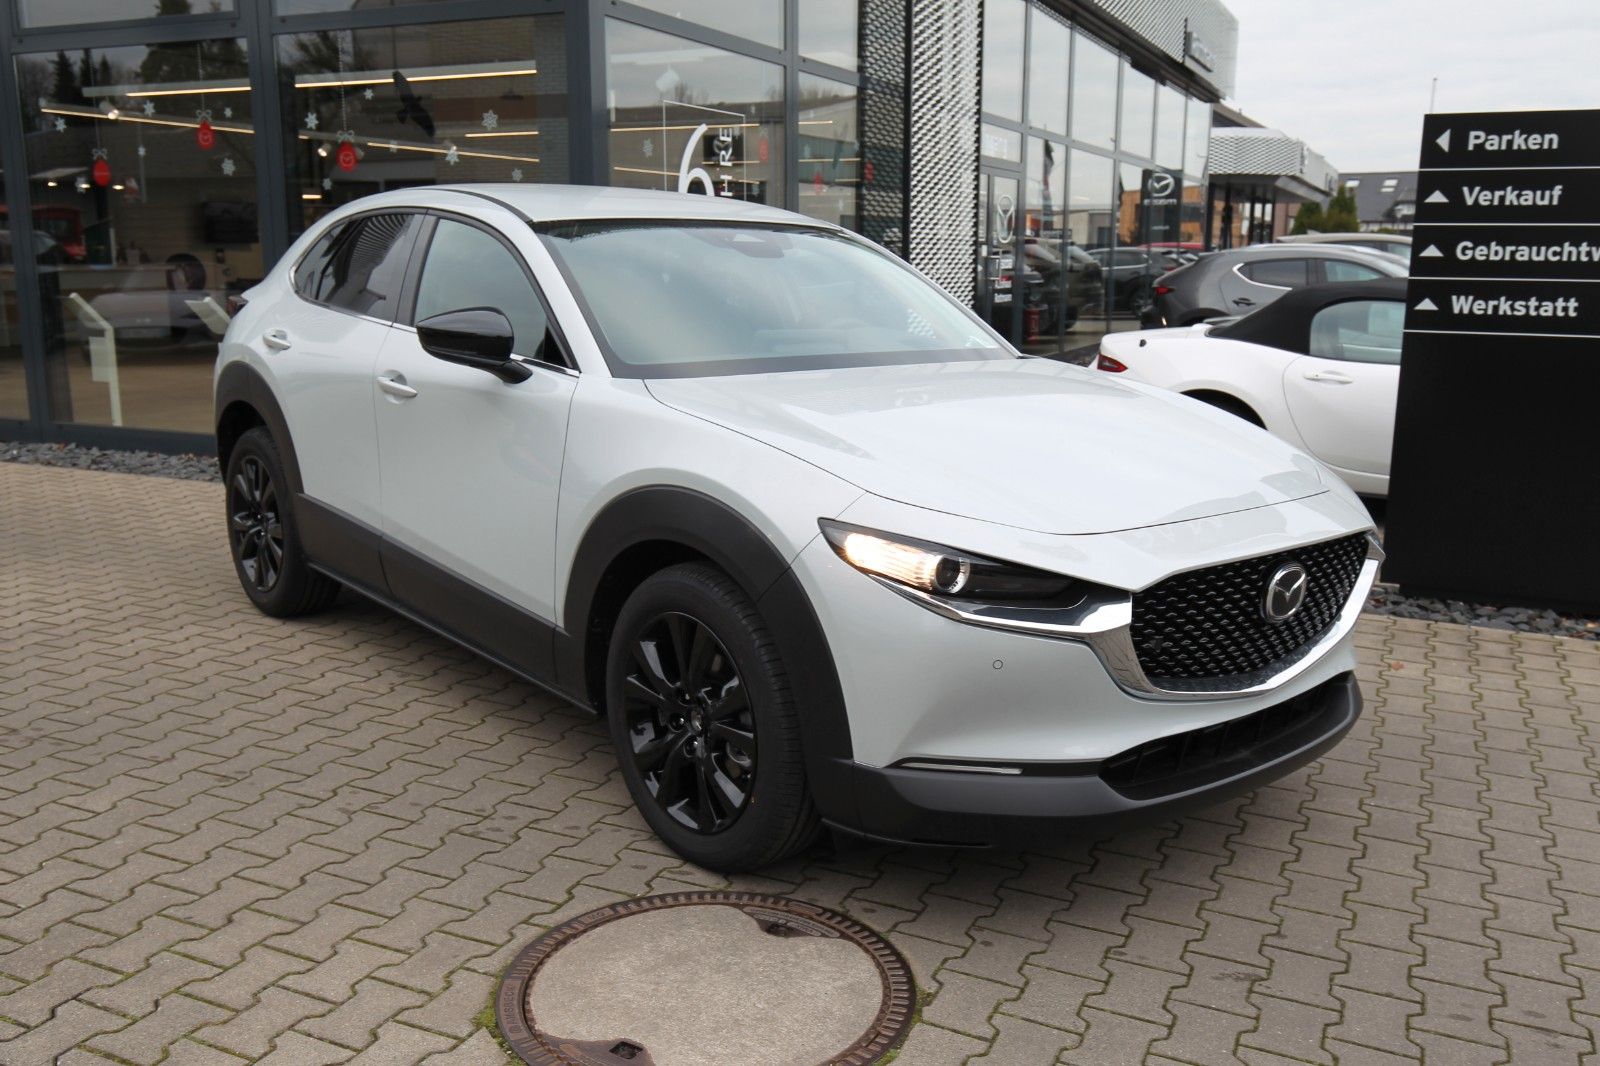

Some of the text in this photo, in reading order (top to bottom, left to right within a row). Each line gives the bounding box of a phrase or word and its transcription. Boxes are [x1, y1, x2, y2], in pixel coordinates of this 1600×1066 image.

[1467, 129, 1559, 151] Parken
[1462, 185, 1563, 206] Verkauf
[1451, 295, 1579, 317] Werkstatt
